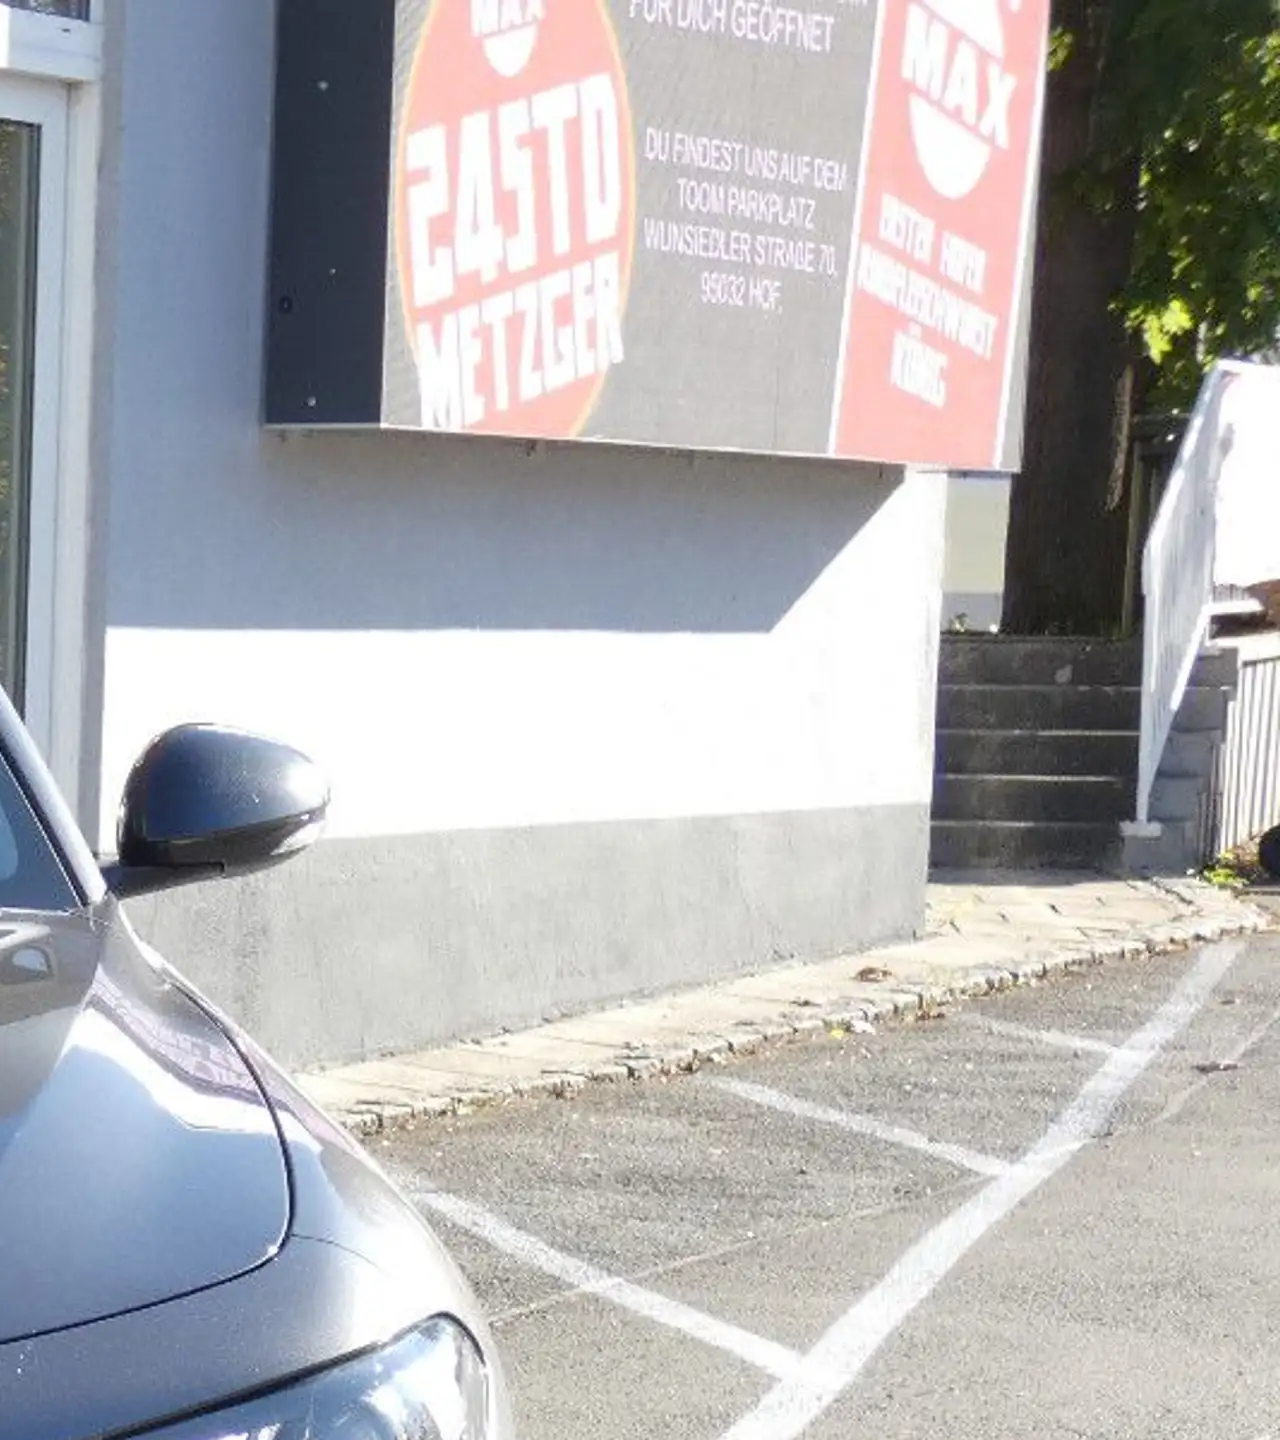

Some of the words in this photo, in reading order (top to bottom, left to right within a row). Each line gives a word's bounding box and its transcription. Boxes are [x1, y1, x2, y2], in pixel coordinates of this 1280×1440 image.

[900, 2, 1018, 150] MAX
[644, 126, 669, 164] DU
[672, 128, 739, 176] FINDEST
[741, 143, 779, 182] UNS
[780, 150, 811, 186] AUF
[812, 156, 846, 194] DEM
[676, 174, 724, 218] TOOM
[727, 180, 816, 235] PARKPLATZ
[415, 250, 624, 430] METZGER
